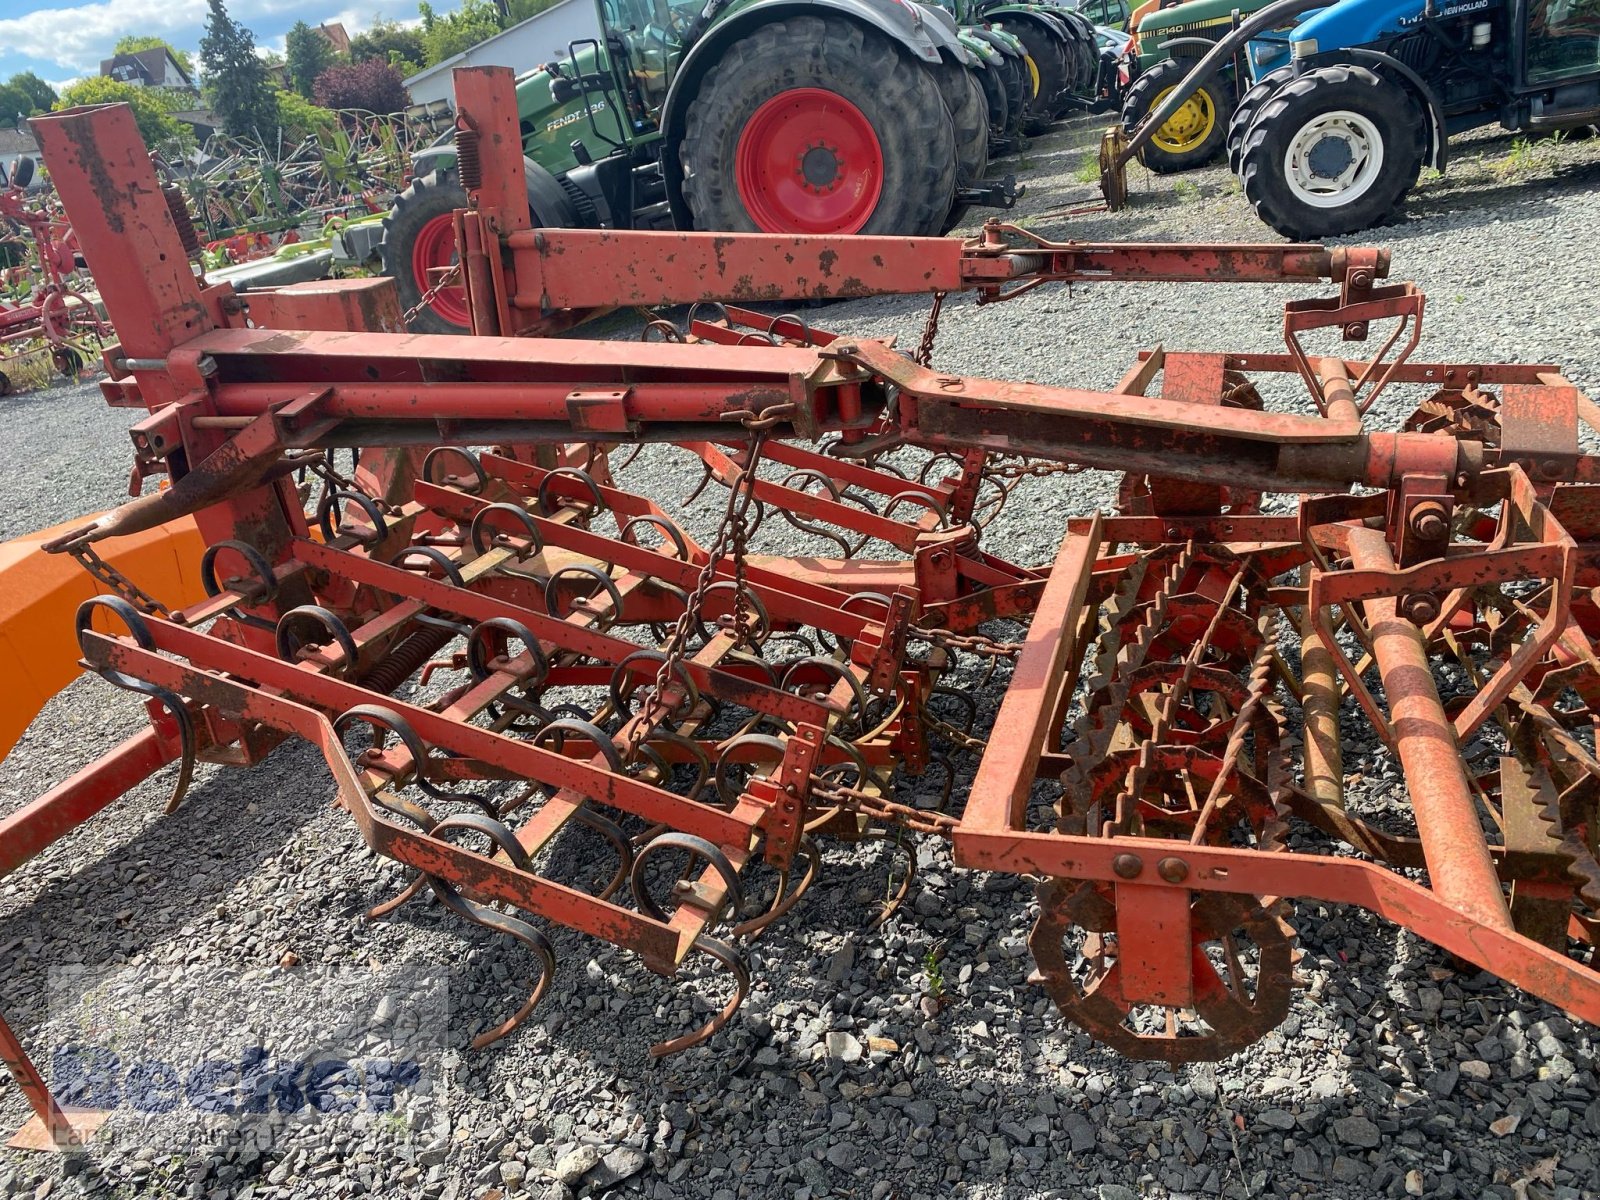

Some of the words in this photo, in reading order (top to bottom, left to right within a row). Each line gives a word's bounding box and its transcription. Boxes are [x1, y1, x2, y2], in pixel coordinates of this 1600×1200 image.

[1444, 6, 1458, 15] NEW
[1458, 0, 1488, 12] HOLLAND
[1159, 25, 1184, 35] 2140
[547, 110, 581, 131] FENDT
